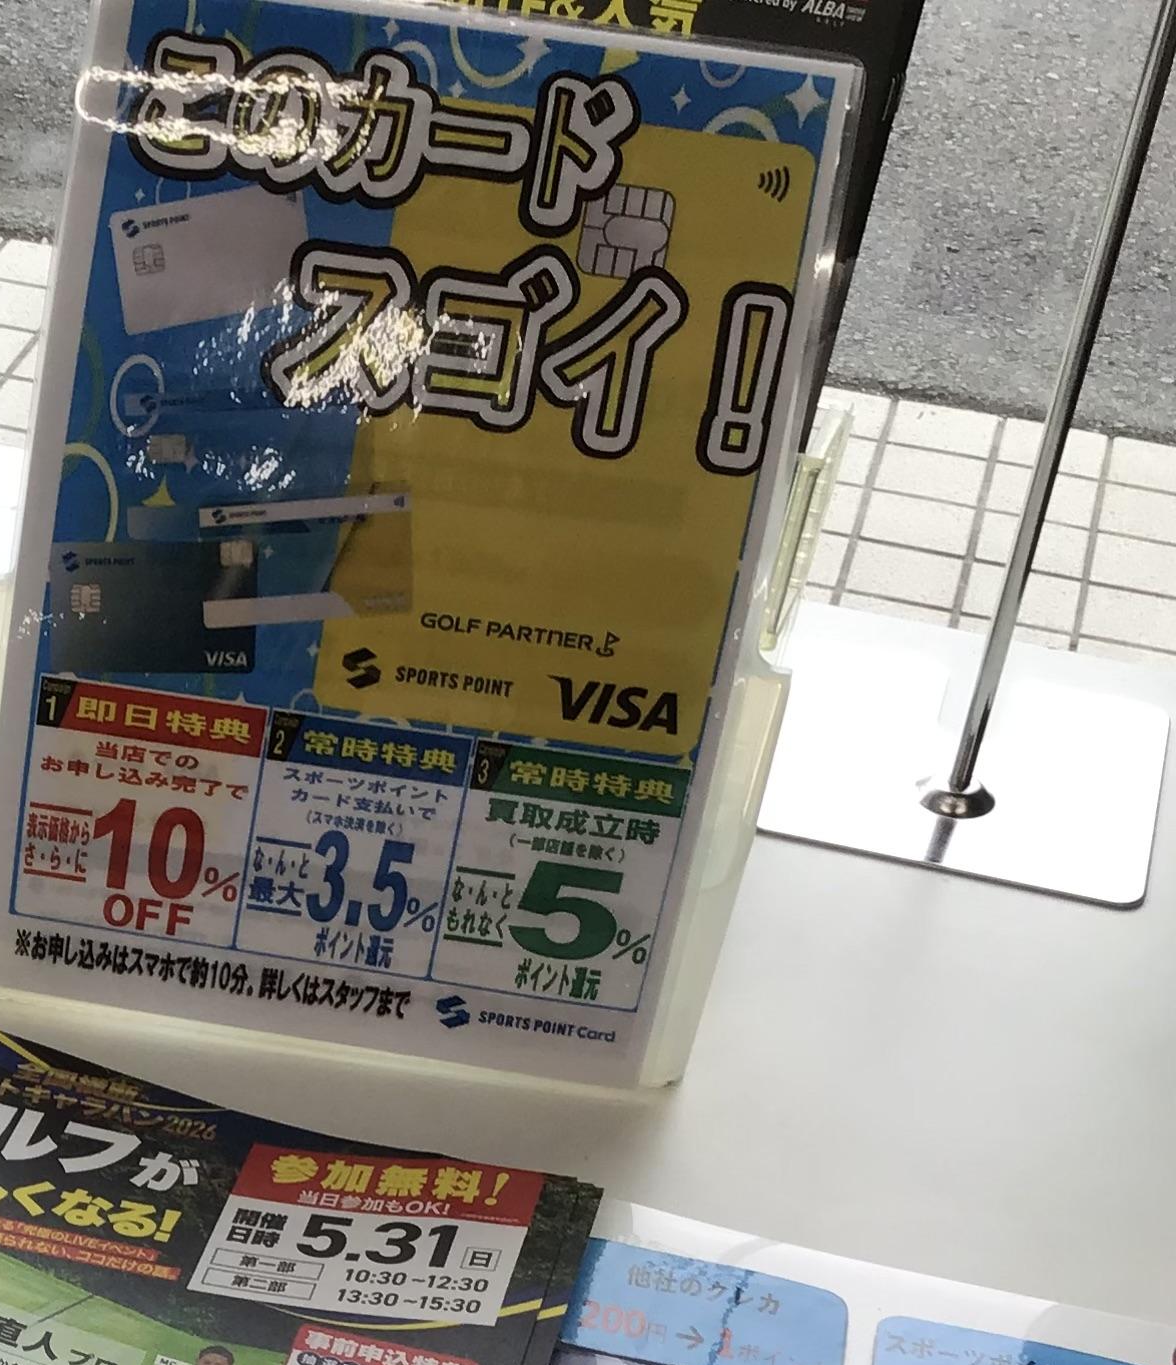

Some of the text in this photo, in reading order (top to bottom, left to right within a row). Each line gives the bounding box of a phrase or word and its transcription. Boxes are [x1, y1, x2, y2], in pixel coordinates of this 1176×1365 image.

[142, 42, 638, 225] このカード
[273, 246, 685, 454] スゴイ
[420, 612, 481, 634] GOLF
[395, 666, 514, 697] SPORTS POINT
[76, 696, 251, 744] 即日特典
[548, 675, 679, 735] VISA
[95, 741, 199, 770] 当店での
[303, 730, 457, 773] 常時特典
[40, 756, 249, 800] お申し込み完了で
[283, 767, 448, 803] スポーツポイント
[510, 760, 674, 804] 常時特典
[291, 788, 437, 821] カード支払いで
[485, 799, 660, 845] 買取成立時
[92, 798, 240, 902] 10%
[248, 880, 303, 908] 最大
[305, 830, 439, 932] 3.5%
[103, 894, 194, 935] OFF
[447, 908, 504, 939] もれなく
[508, 860, 651, 965] 5%
[314, 928, 393, 969] ポイント還元
[515, 959, 601, 1000] ポイント還元
[479, 1010, 616, 1042] SPORTS POINT Card
[270, 1154, 510, 1207] 参加無料!
[231, 1208, 288, 1230] 開催
[297, 1190, 450, 1216] 当日参加もOK!
[226, 1227, 280, 1249] 日時
[296, 1214, 459, 1268] 5.31
[230, 1275, 288, 1294] 第二部
[238, 1255, 297, 1273] 第一部
[628, 1265, 781, 1315] 他社のクレカ
